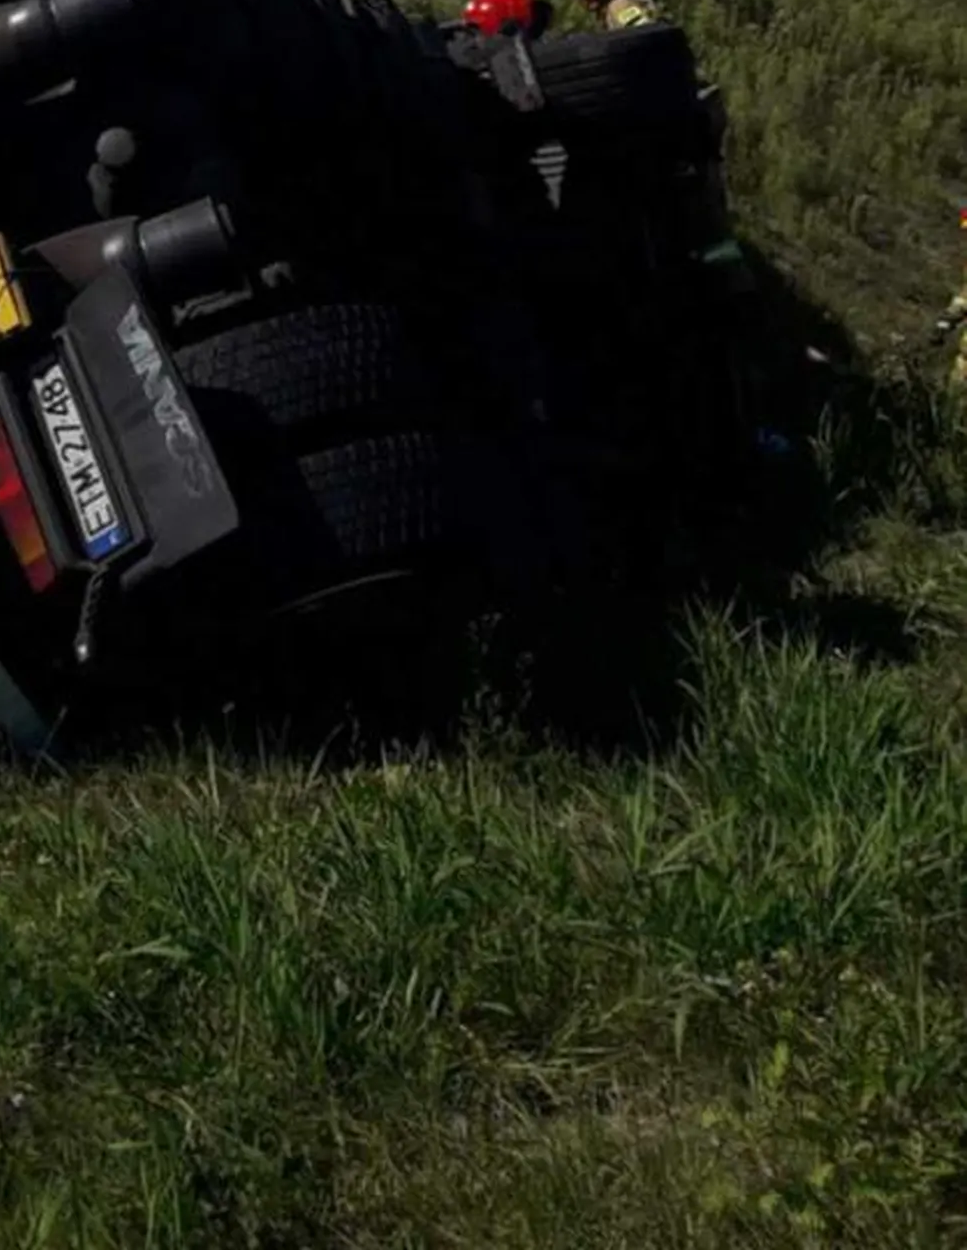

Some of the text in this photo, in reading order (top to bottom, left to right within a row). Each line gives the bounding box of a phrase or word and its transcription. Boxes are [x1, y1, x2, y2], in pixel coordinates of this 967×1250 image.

[39, 377, 119, 538] ETM 2748
[116, 303, 214, 498] SCANIA
